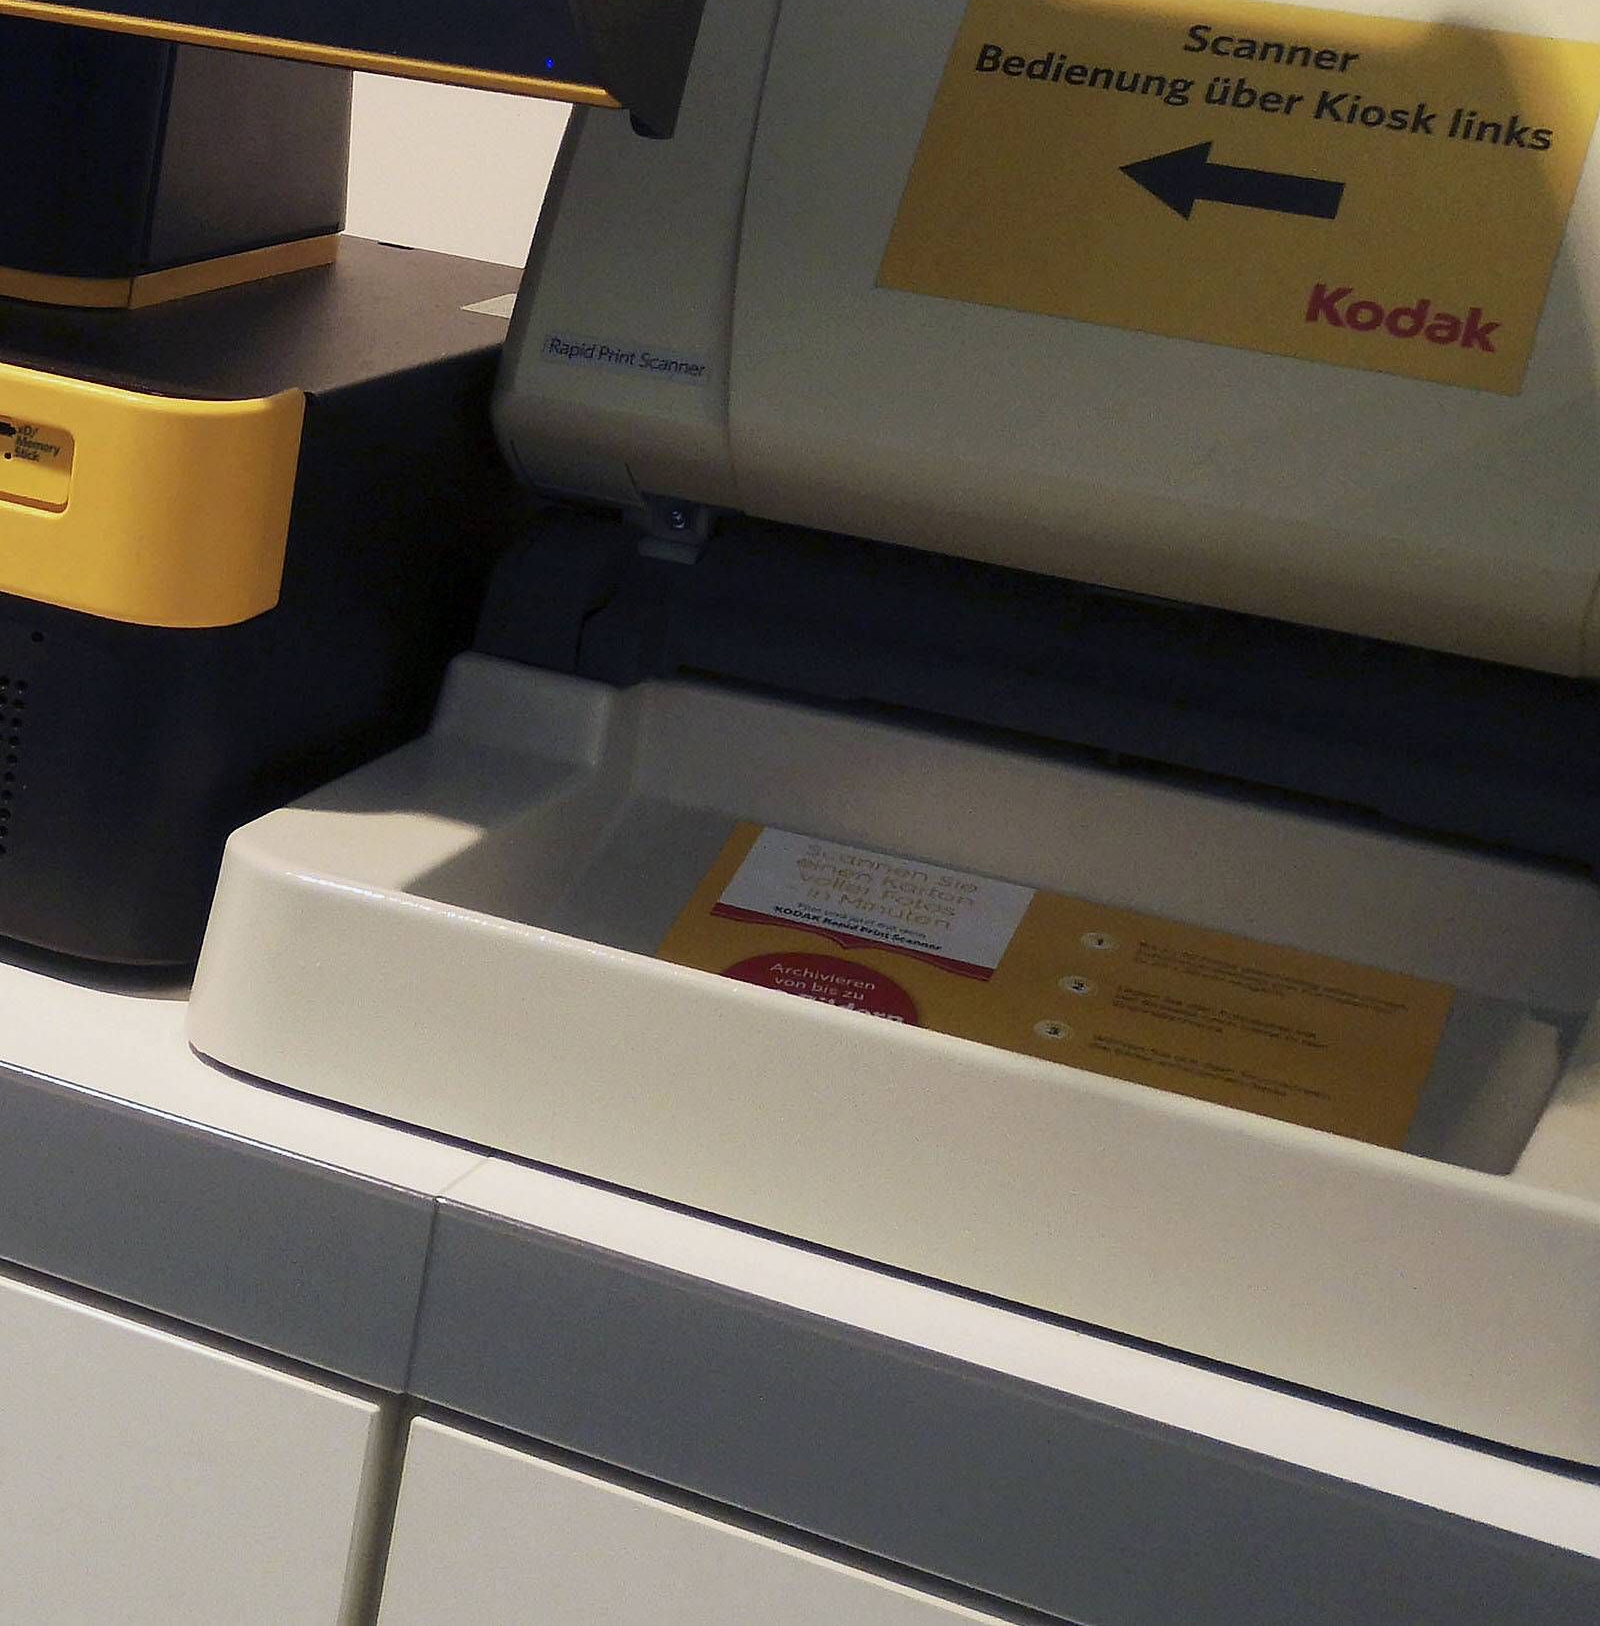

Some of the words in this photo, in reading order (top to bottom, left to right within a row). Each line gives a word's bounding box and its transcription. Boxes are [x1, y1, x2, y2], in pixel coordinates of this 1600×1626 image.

[1183, 24, 1359, 76] Scanner
[975, 44, 1194, 107] Bedienung
[1203, 76, 1304, 116] über
[1313, 87, 1437, 136] Kiosk
[1447, 107, 1553, 152] links
[1305, 282, 1501, 354] Kodak
[549, 336, 594, 363] Rapid
[599, 345, 634, 368] Print
[639, 350, 706, 378] Scanner
